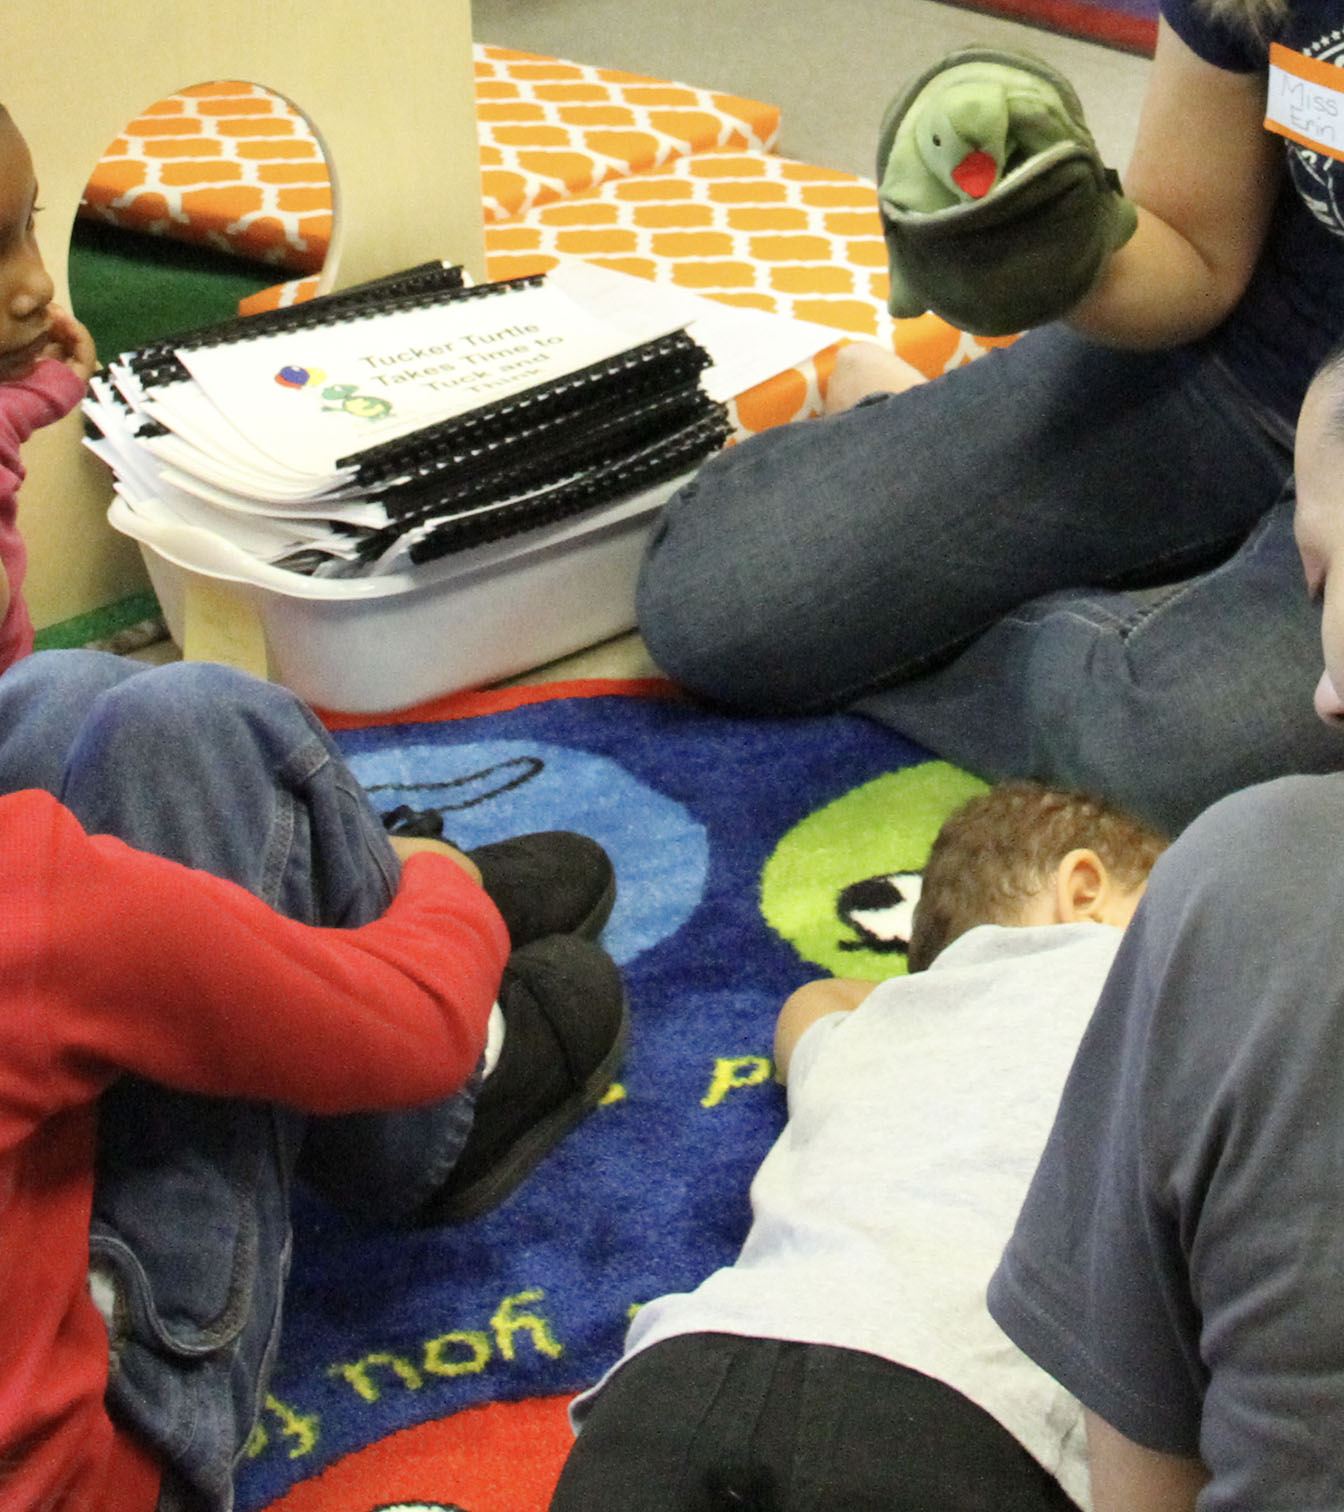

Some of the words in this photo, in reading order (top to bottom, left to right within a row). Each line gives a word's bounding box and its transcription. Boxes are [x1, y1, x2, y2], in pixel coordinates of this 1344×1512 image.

[1280, 73, 1340, 119] Miss
[1289, 103, 1337, 144] Erin
[357, 338, 455, 370] Tucker
[459, 323, 541, 348] Turtle
[369, 360, 456, 388] Takes
[459, 343, 530, 366] Time
[532, 334, 565, 349] to
[419, 368, 492, 392] Tuck
[499, 352, 551, 374] and
[464, 366, 541, 394] Think
